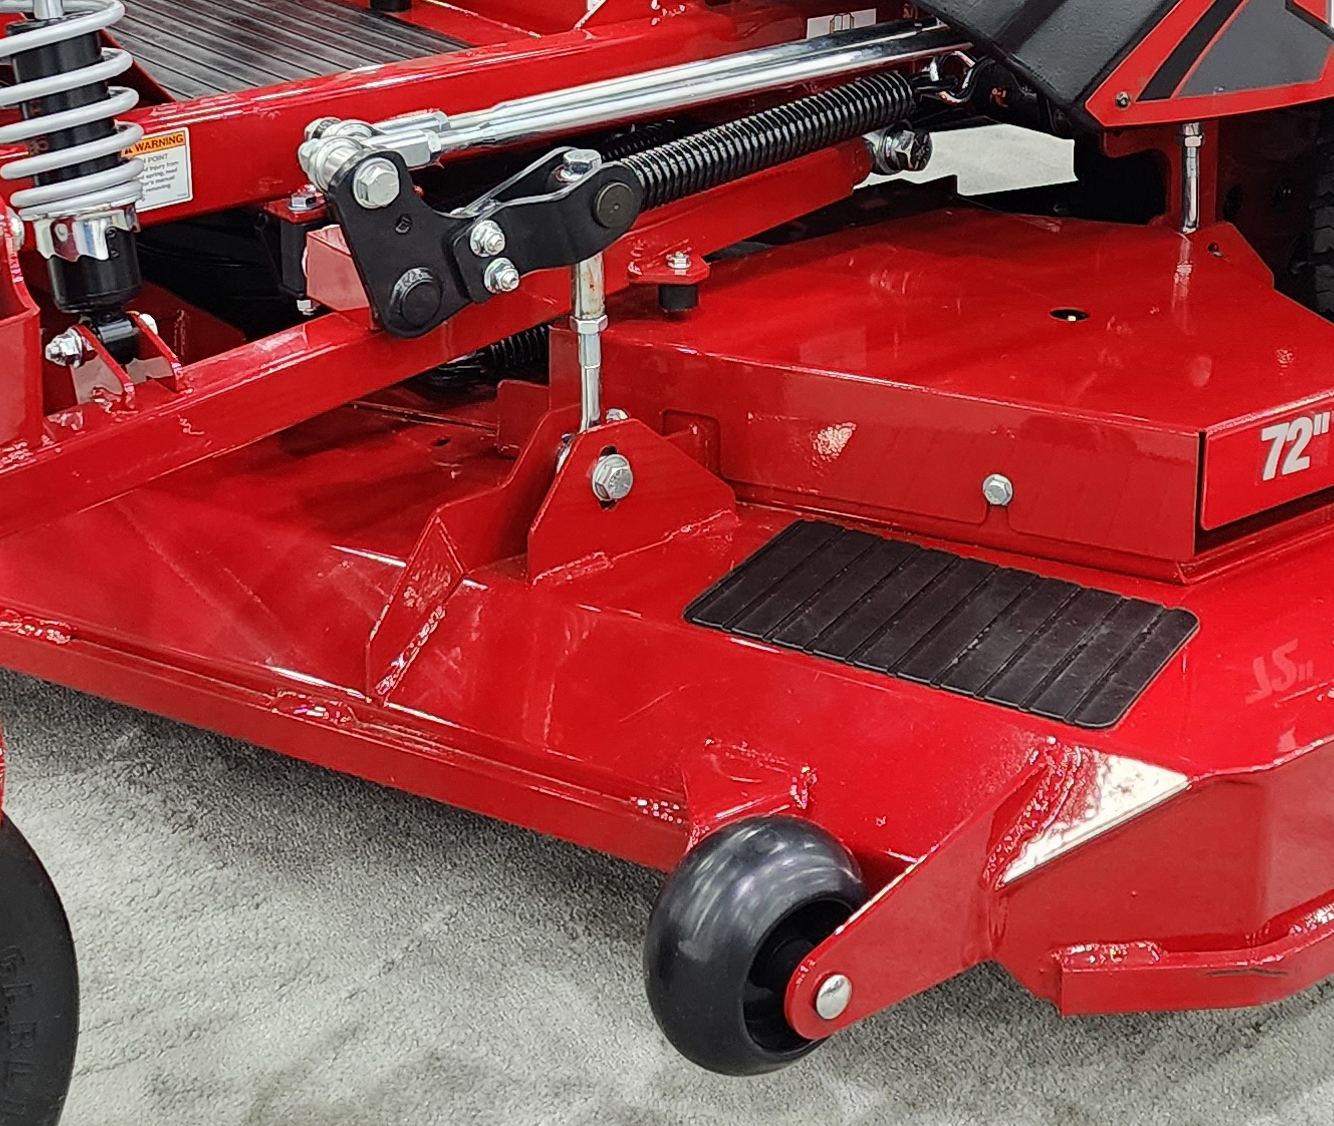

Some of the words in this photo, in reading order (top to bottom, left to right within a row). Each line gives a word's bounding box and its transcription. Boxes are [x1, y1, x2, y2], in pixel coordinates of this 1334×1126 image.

[135, 134, 184, 152] WARNING
[148, 153, 169, 163] POINT
[1260, 411, 1331, 482] 72"
